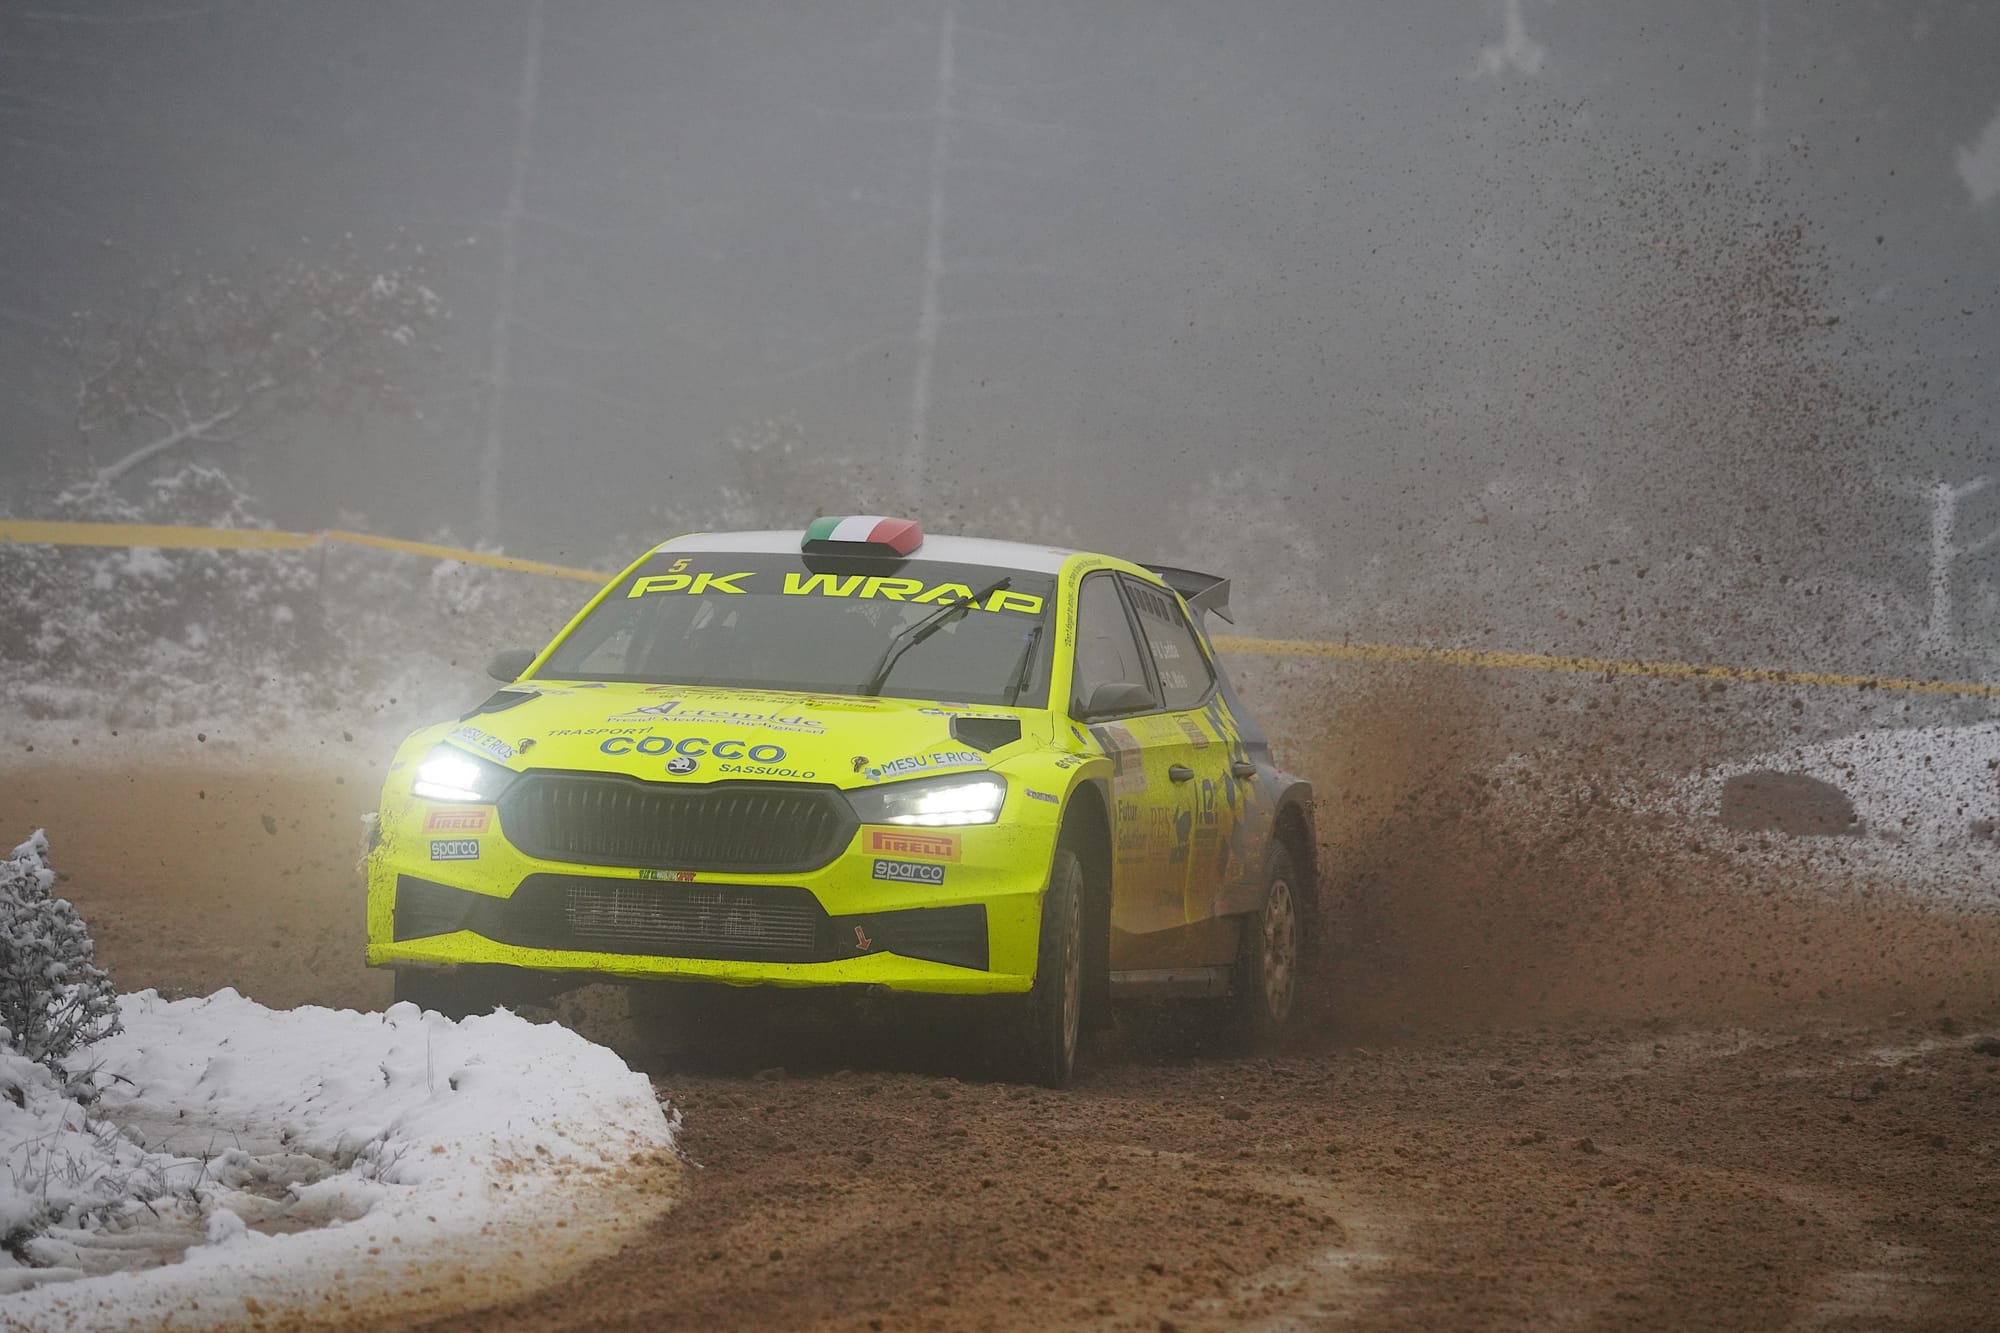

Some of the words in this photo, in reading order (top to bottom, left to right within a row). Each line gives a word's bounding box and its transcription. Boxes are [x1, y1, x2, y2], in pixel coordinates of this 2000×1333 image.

[668, 558, 694, 573] 5
[627, 572, 757, 599] PK
[783, 572, 1044, 614] WRAP
[600, 736, 787, 765] COCCO
[719, 763, 816, 779] SASSUOLO
[880, 754, 927, 774] MESU
[429, 811, 486, 829] PIRELLI
[431, 840, 478, 859] sparco
[872, 831, 953, 856] PIRELLI
[875, 861, 943, 880] sparco
